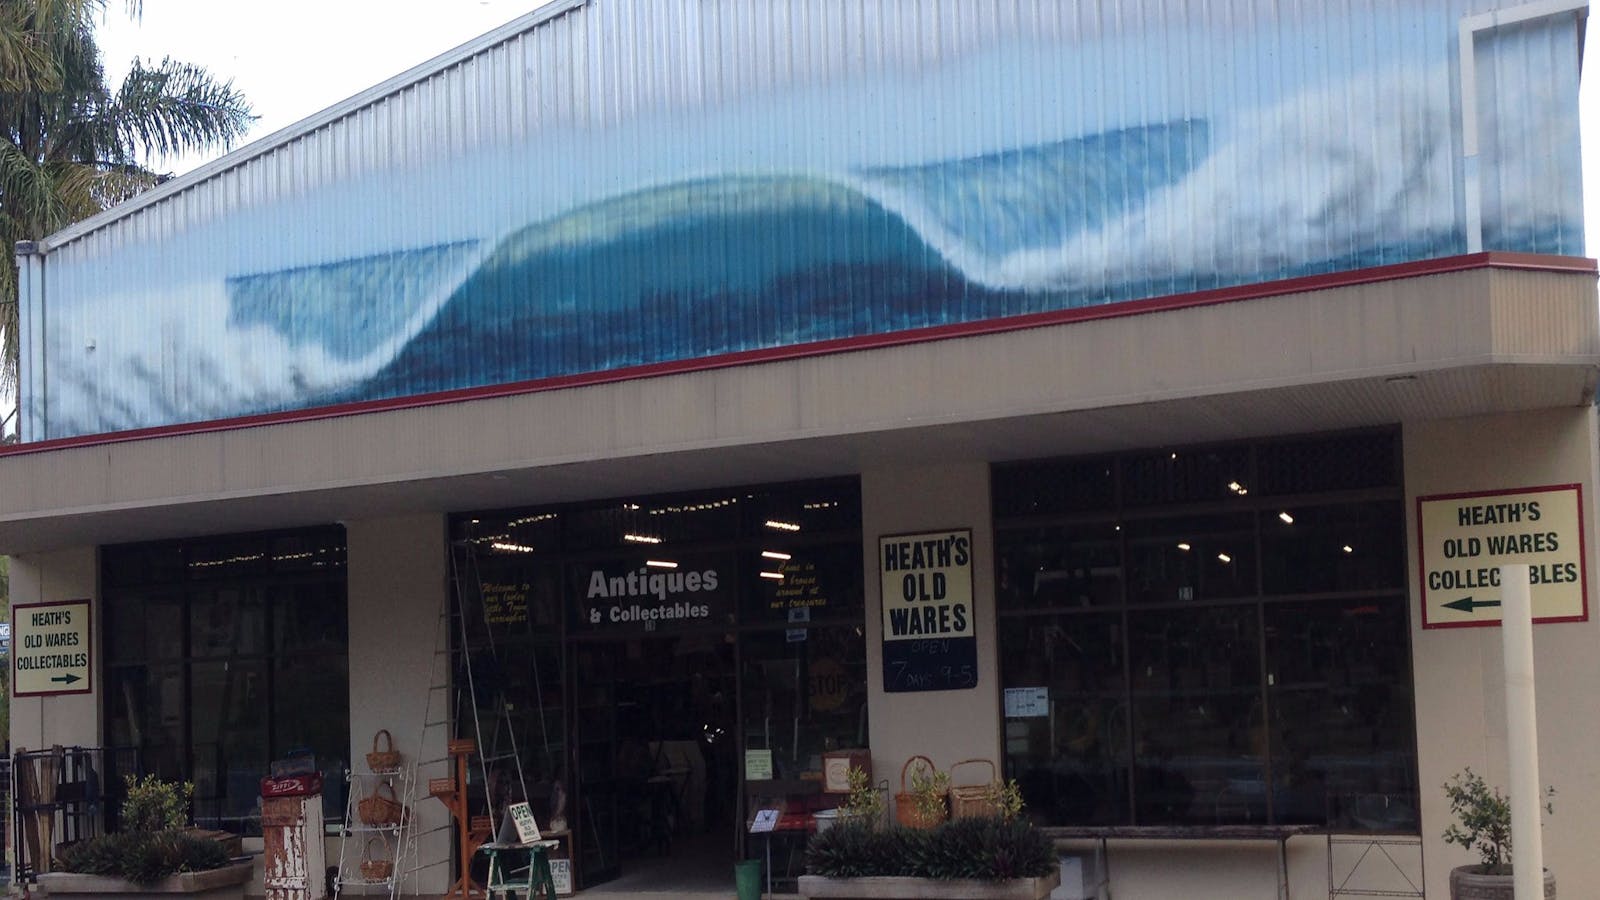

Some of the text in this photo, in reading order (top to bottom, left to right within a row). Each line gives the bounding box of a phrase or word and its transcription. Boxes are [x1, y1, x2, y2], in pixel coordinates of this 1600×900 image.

[1458, 502, 1541, 526] HEATH'S
[885, 535, 969, 571] HEATH'S
[1443, 532, 1559, 559] OLD WARES
[587, 568, 718, 600] Antiques
[903, 573, 946, 602] OLD
[1429, 563, 1577, 591] COLLECBLES
[32, 611, 71, 626] HEATH'S
[590, 602, 709, 623] & Collectables
[890, 604, 967, 636] WARES
[25, 635, 42, 648] OLD
[45, 632, 79, 647] WARES
[912, 639, 951, 654] OPEN
[17, 653, 87, 670] COLLECTABLES
[511, 804, 534, 820] OPEN
[551, 861, 571, 873] PEN
